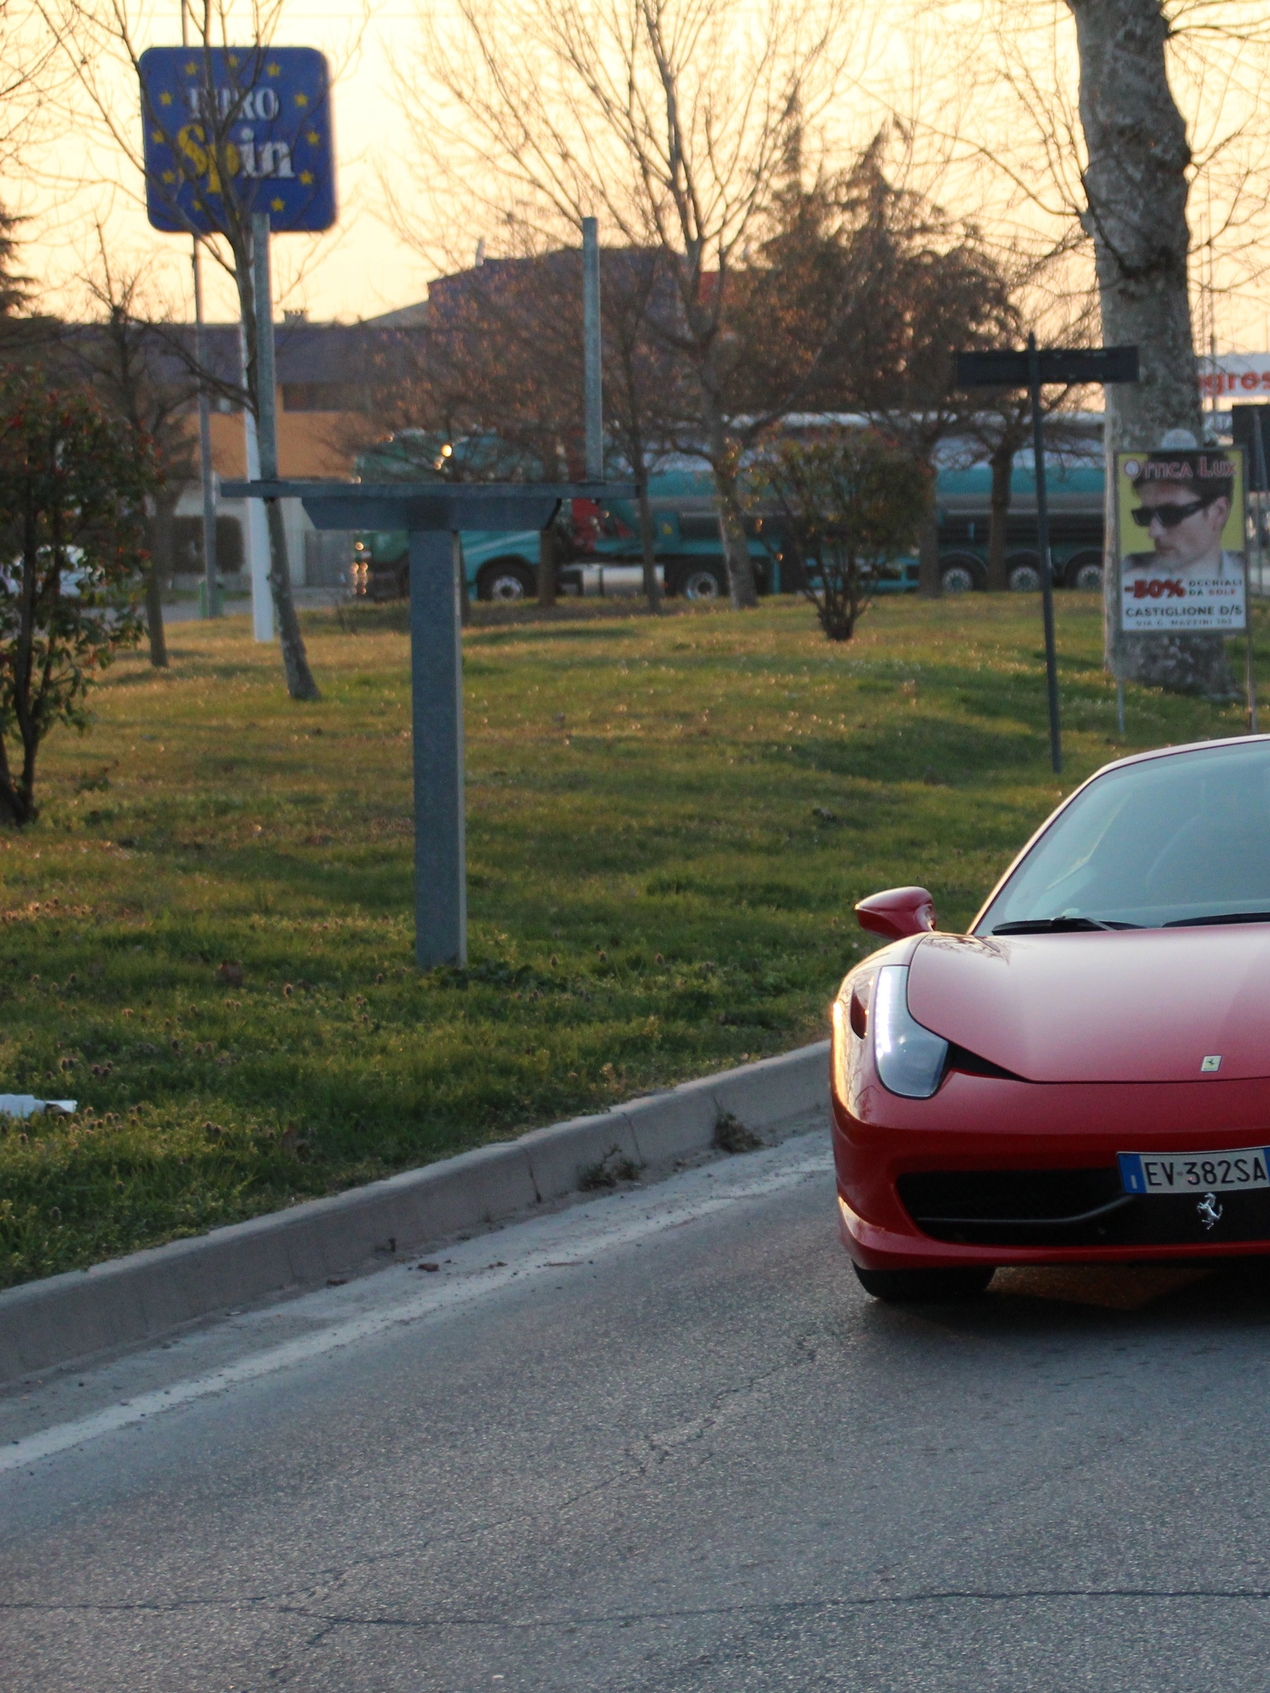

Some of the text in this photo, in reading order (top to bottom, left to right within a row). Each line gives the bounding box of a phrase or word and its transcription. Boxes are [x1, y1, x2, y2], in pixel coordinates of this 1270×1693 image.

[1188, 579, 1243, 588] OCCHIALI
[1188, 588, 1237, 596] DA SOLE
[1126, 604, 1243, 618] CASTIGLIONE D/S
[1144, 1161, 1175, 1187] EV
[1183, 1157, 1267, 1185] 382SA
